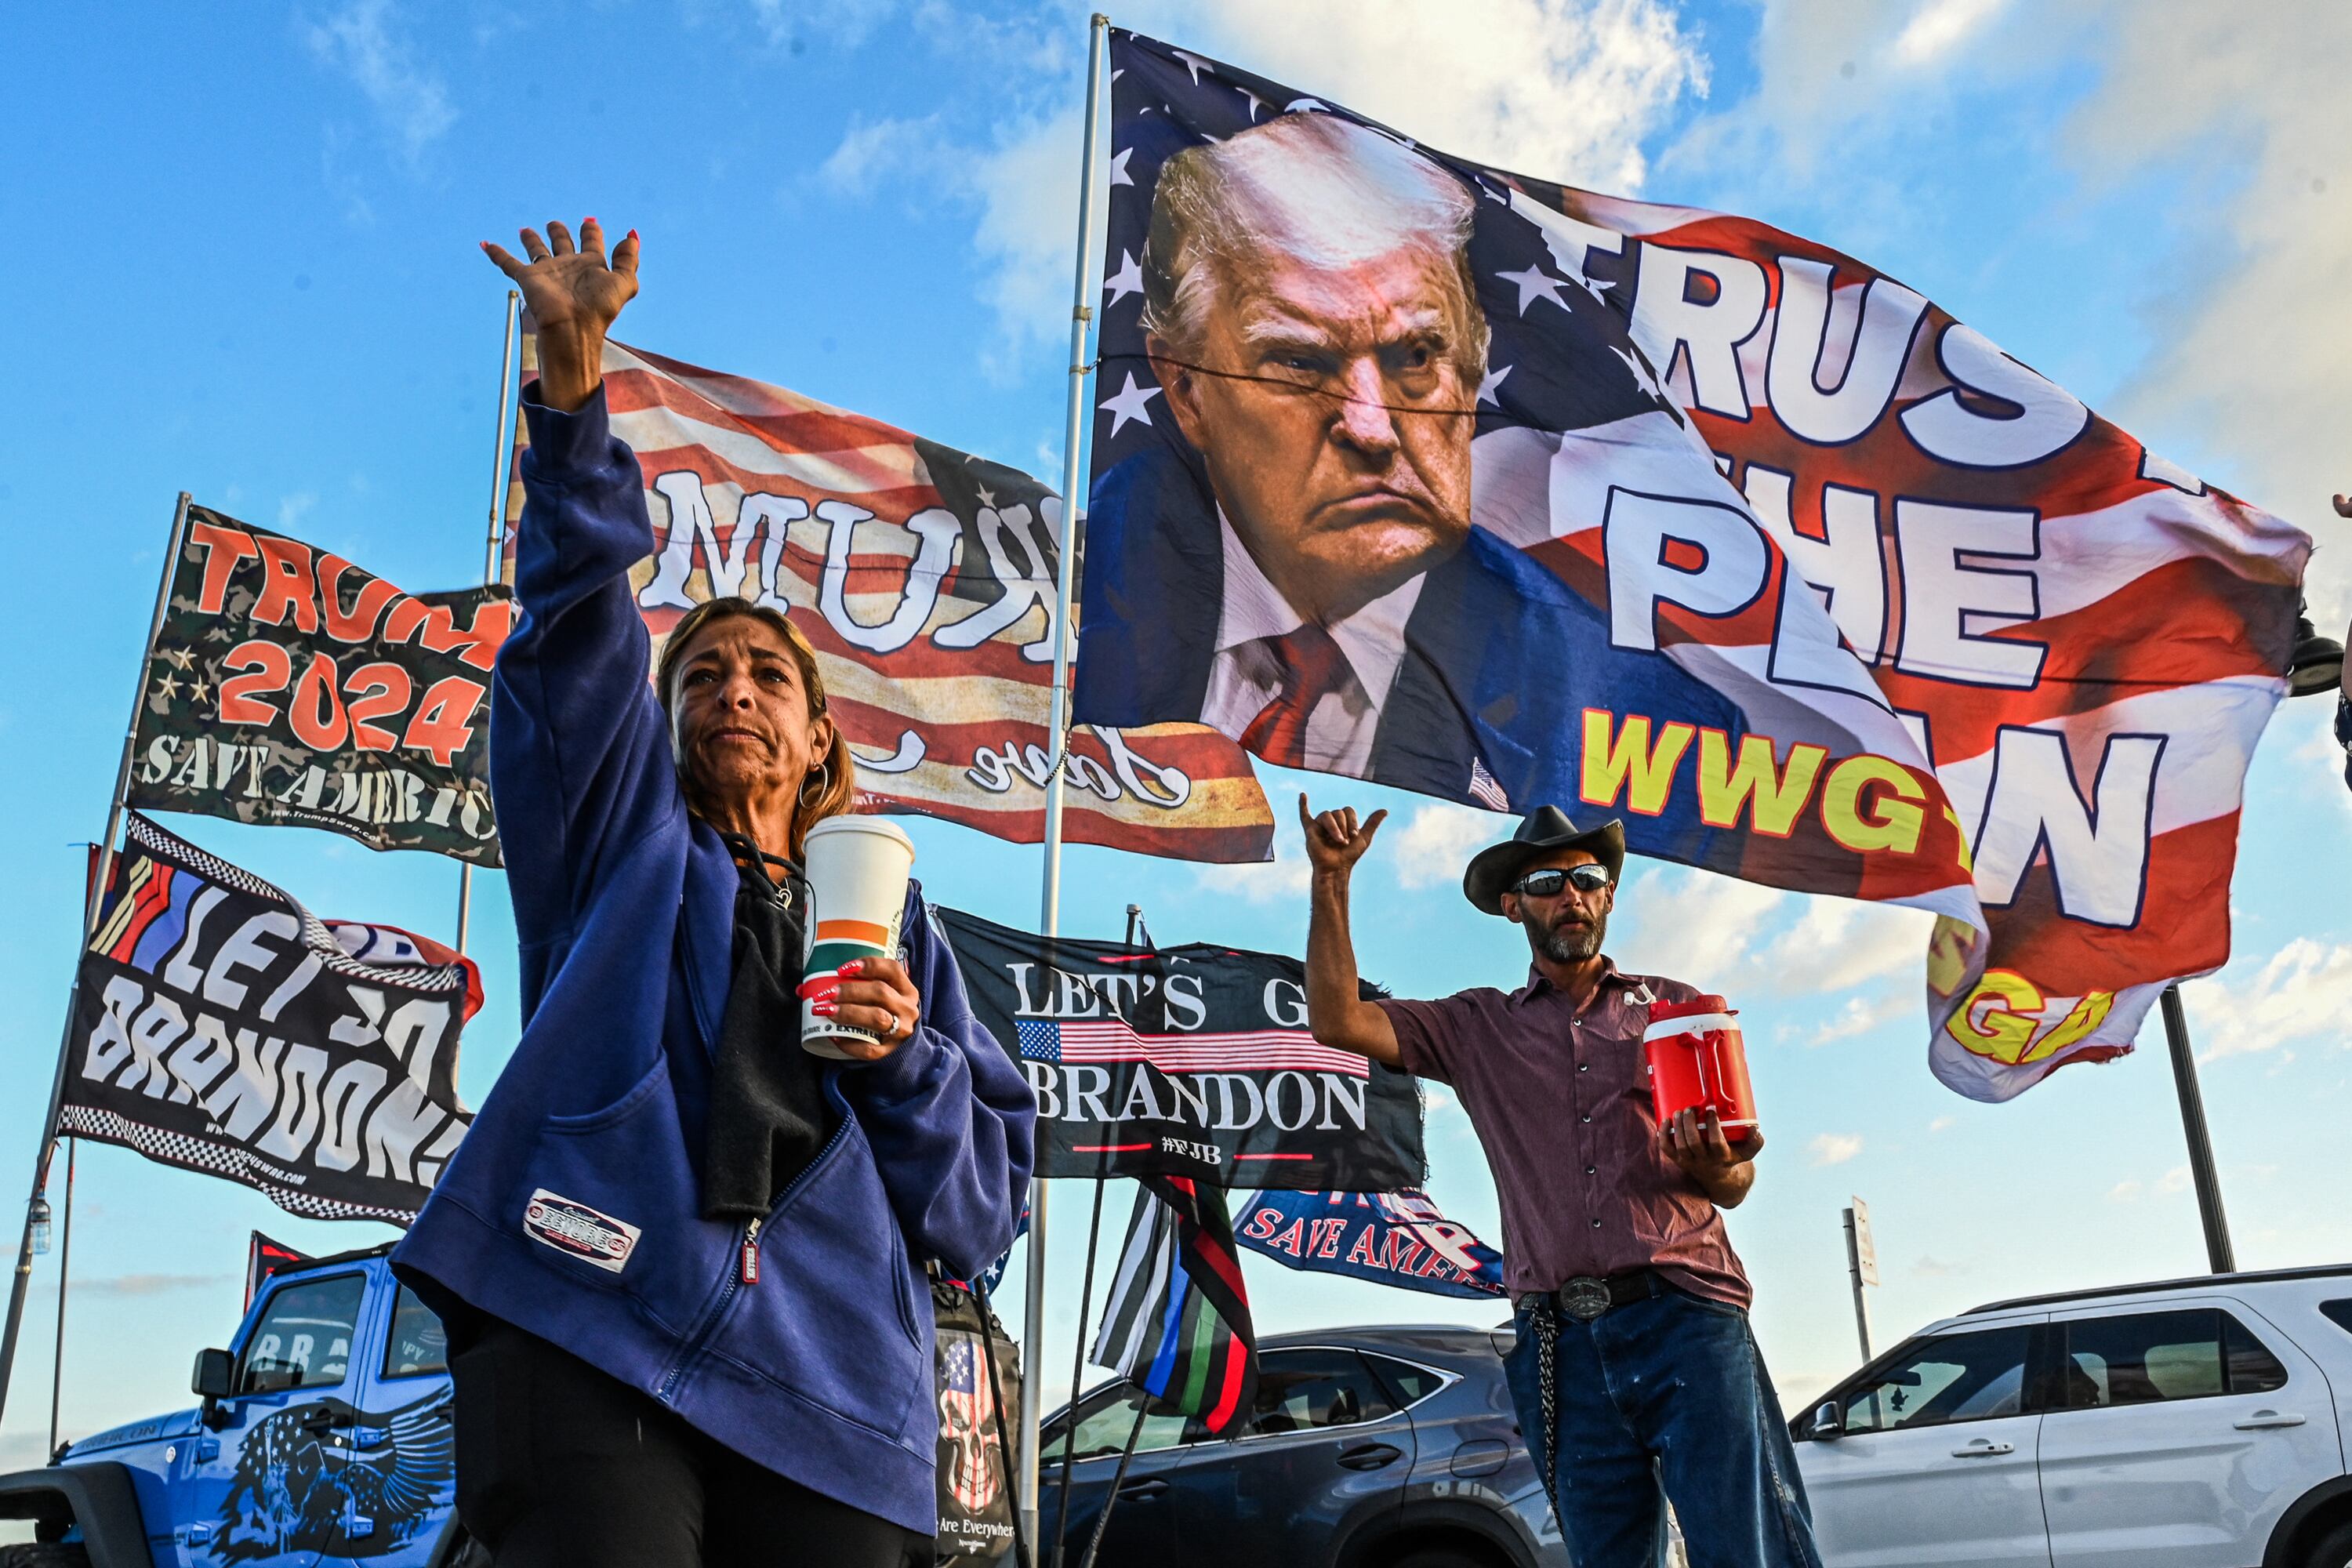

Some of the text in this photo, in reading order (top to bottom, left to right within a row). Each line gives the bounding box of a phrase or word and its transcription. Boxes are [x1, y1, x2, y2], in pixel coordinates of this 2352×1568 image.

[190, 520, 511, 673] TRUM
[1714, 450, 2048, 689] HE
[219, 640, 488, 768] 2024
[275, 764, 496, 840] AMERIC
[1005, 956, 1309, 1032] LET'S G
[1021, 1059, 1370, 1131] BRANDON
[1161, 1136, 1222, 1165] #FJB
[1243, 1207, 1348, 1258] SAVE
[940, 1518, 1014, 1539] Are Everywher
